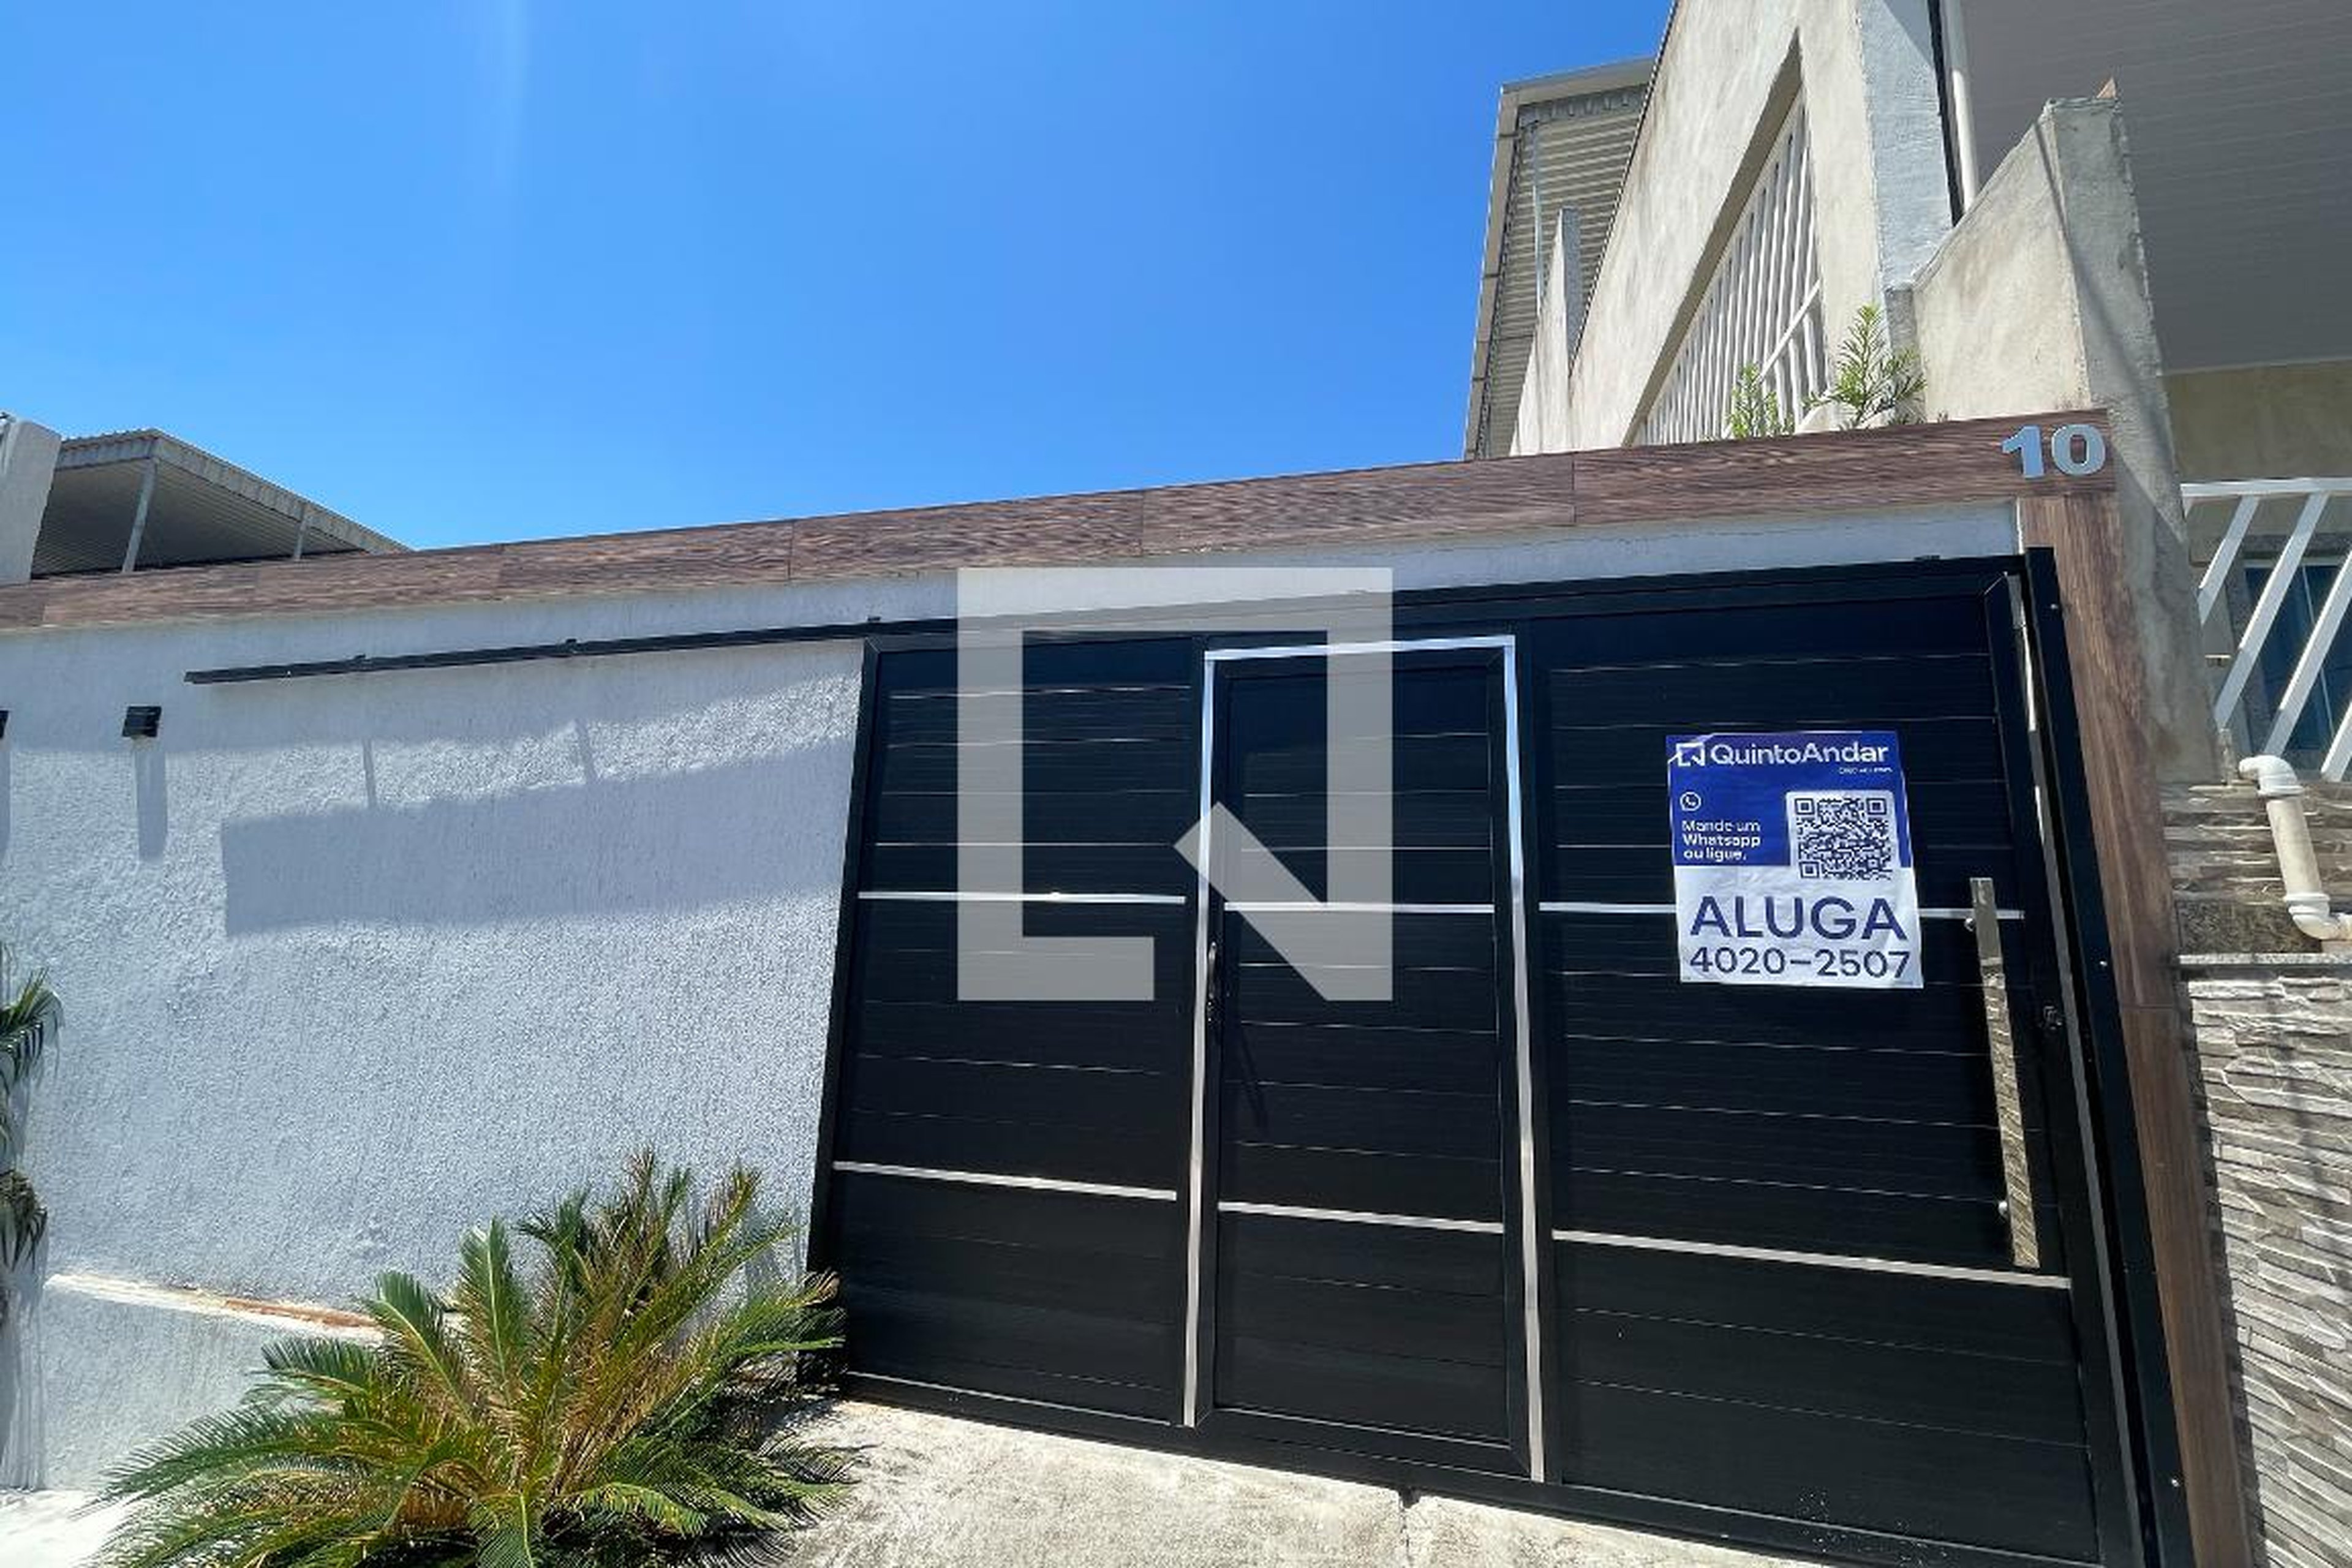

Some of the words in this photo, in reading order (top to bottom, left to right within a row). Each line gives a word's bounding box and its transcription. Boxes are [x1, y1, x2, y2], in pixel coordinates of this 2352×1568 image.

[2002, 424, 2106, 478] 10
[1710, 742, 1889, 765] QuintoAndar
[1681, 820, 1734, 832] Mande
[1736, 822, 1761, 832] um
[1682, 834, 1762, 848] Whatsapp
[1683, 850, 1704, 859] ou
[1690, 896, 1907, 940] ALUGA
[1689, 947, 1910, 978] 4020-2507
